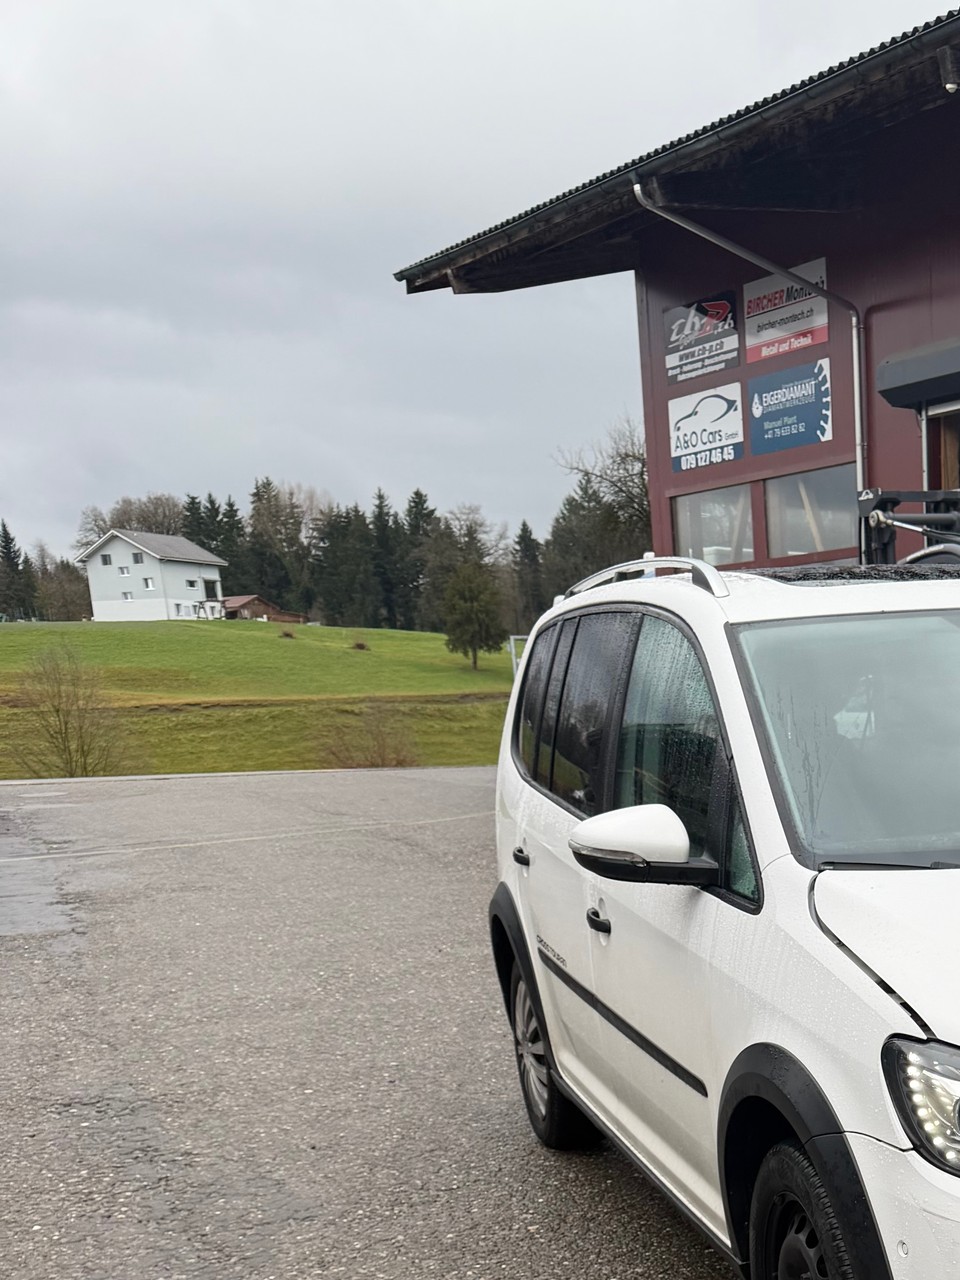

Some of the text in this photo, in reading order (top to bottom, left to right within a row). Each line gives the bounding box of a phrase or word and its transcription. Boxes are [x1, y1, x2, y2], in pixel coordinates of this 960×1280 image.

[746, 289, 785, 316] BIRCHER
[762, 381, 816, 407] EIGERDIAMANT
[674, 430, 699, 453] A&O
[700, 428, 723, 445] Cars
[680, 445, 735, 471] 079 127 46 45
